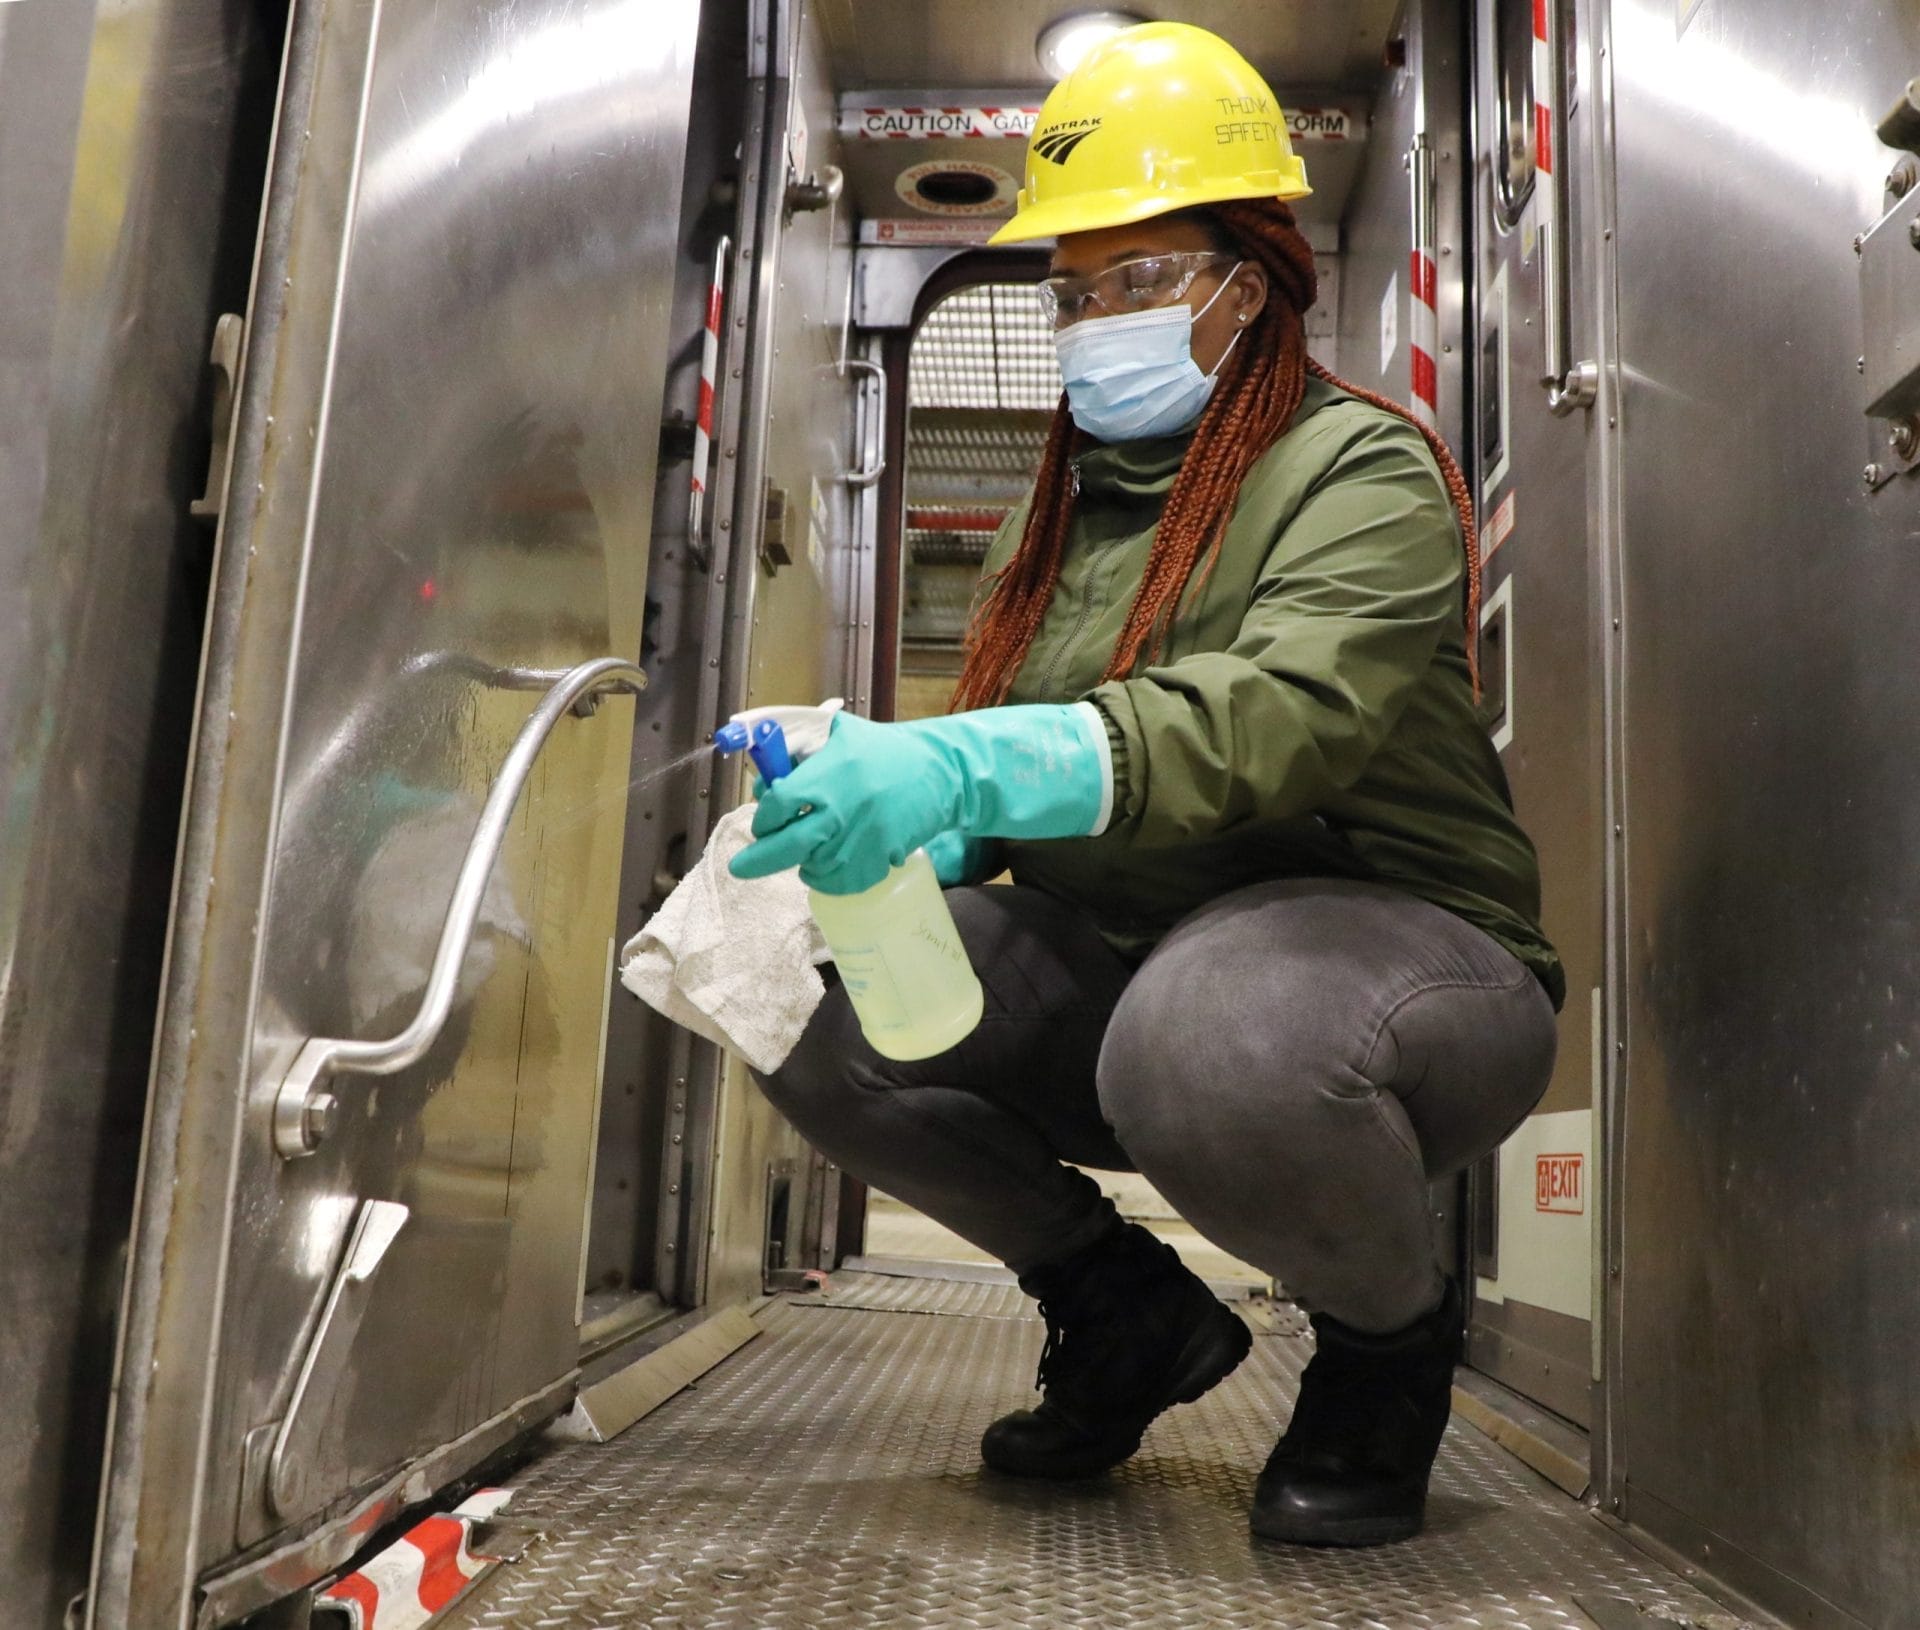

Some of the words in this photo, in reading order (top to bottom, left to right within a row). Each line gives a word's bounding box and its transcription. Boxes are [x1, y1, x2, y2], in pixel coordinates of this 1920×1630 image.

[1215, 97, 1269, 115] THINK
[866, 115, 971, 132] CAUTION
[993, 114, 1036, 130] GAP
[1284, 115, 1343, 131] FORM
[1042, 117, 1102, 135] AMTRAK
[1214, 122, 1278, 144] SAFETY
[1551, 1160, 1581, 1199] EXIT
